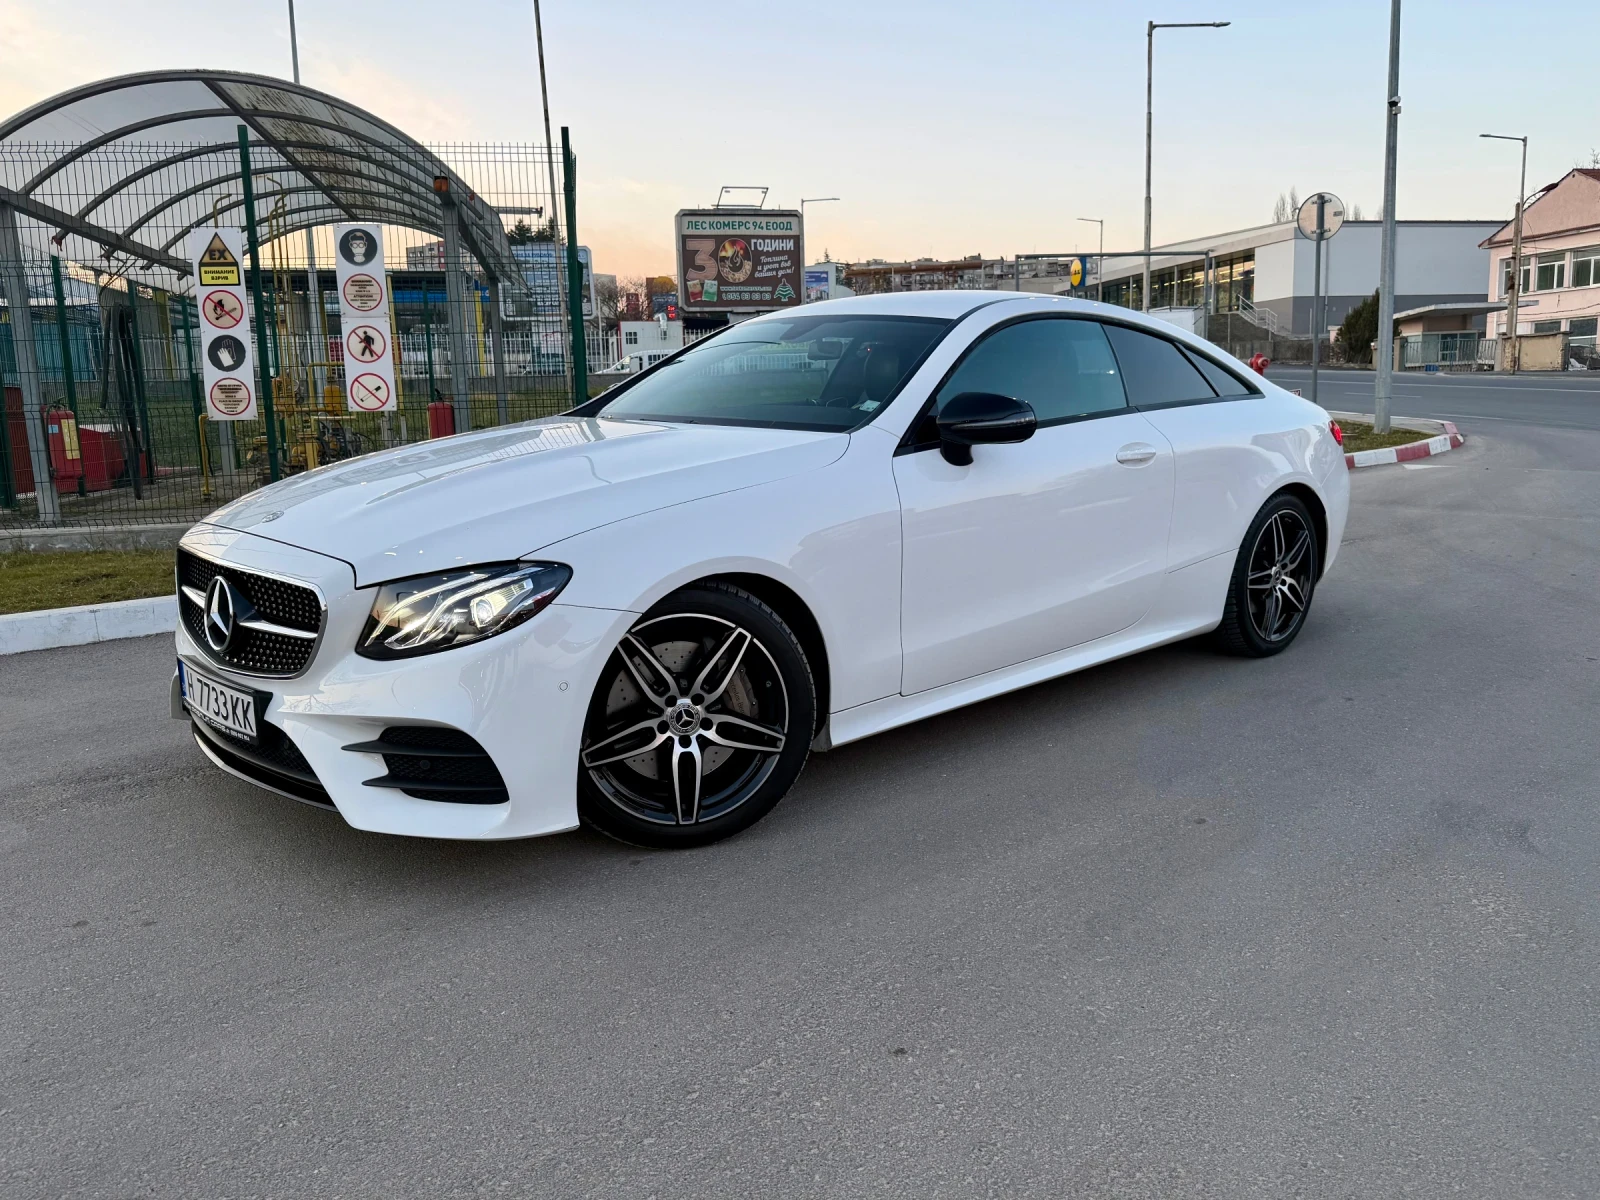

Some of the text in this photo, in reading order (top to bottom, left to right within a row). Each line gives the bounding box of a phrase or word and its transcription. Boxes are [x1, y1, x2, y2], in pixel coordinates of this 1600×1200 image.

[686, 220, 793, 231] ЛЕС КОМЕРС 94 ЕООД
[750, 239, 794, 252] ГОДИНИ
[208, 249, 228, 261] EX
[186, 669, 196, 702] H
